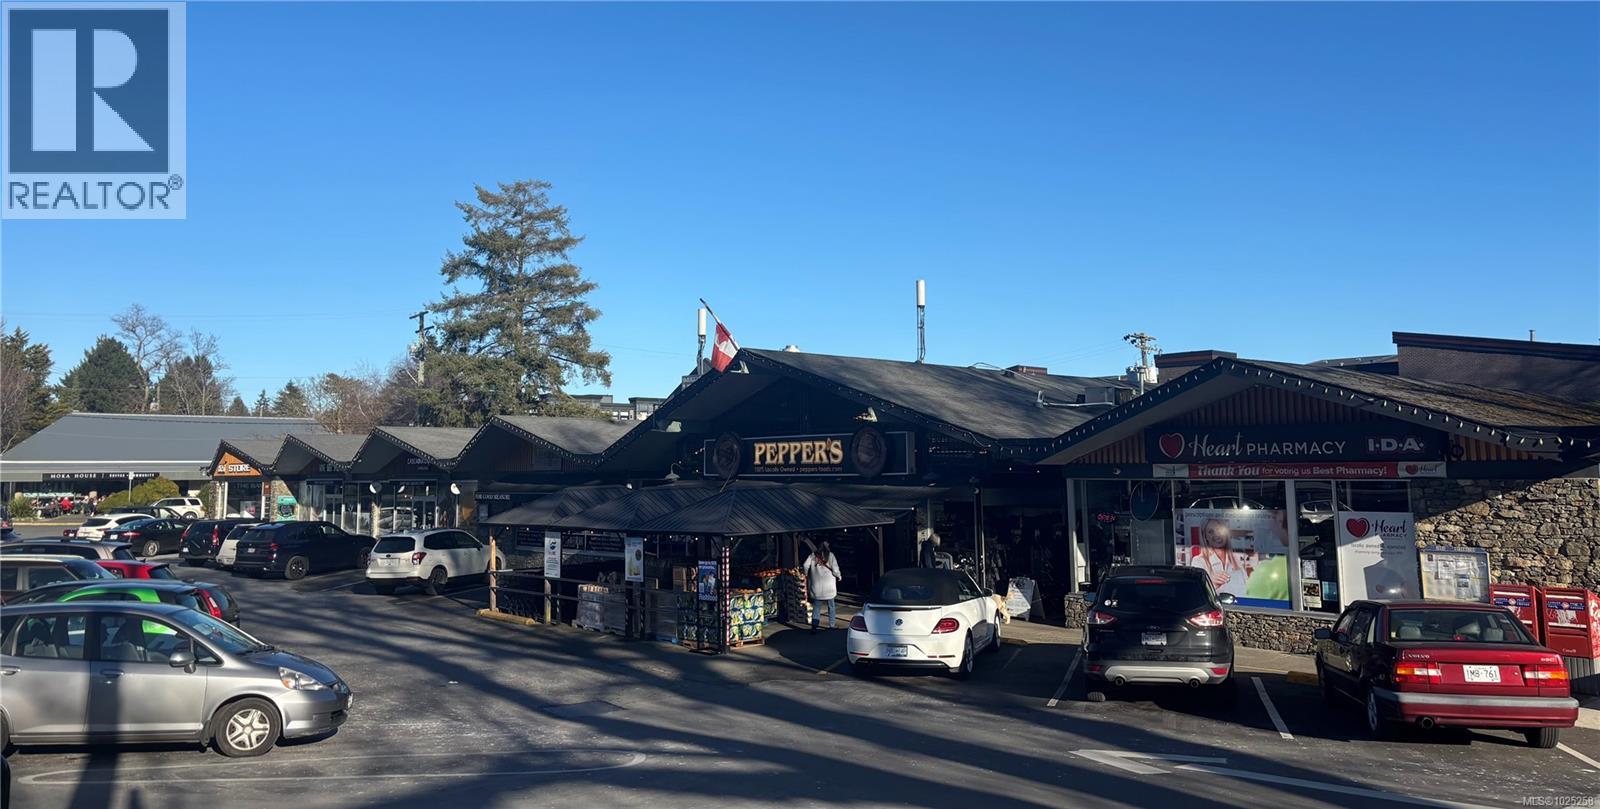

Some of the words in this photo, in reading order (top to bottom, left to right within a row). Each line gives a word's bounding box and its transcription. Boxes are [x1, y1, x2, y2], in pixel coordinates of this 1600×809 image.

[753, 438, 845, 466] PEPPER'S
[1188, 432, 1244, 458] Heart
[1247, 441, 1346, 457] PHARMACY
[228, 463, 252, 473] STORE
[1238, 466, 1260, 477] You
[1262, 466, 1274, 475] for
[1275, 466, 1299, 477] voting
[1301, 467, 1312, 475] us
[1312, 466, 1335, 475] Best
[1336, 465, 1388, 477] Pharmacy!
[1372, 519, 1407, 533] Heart
